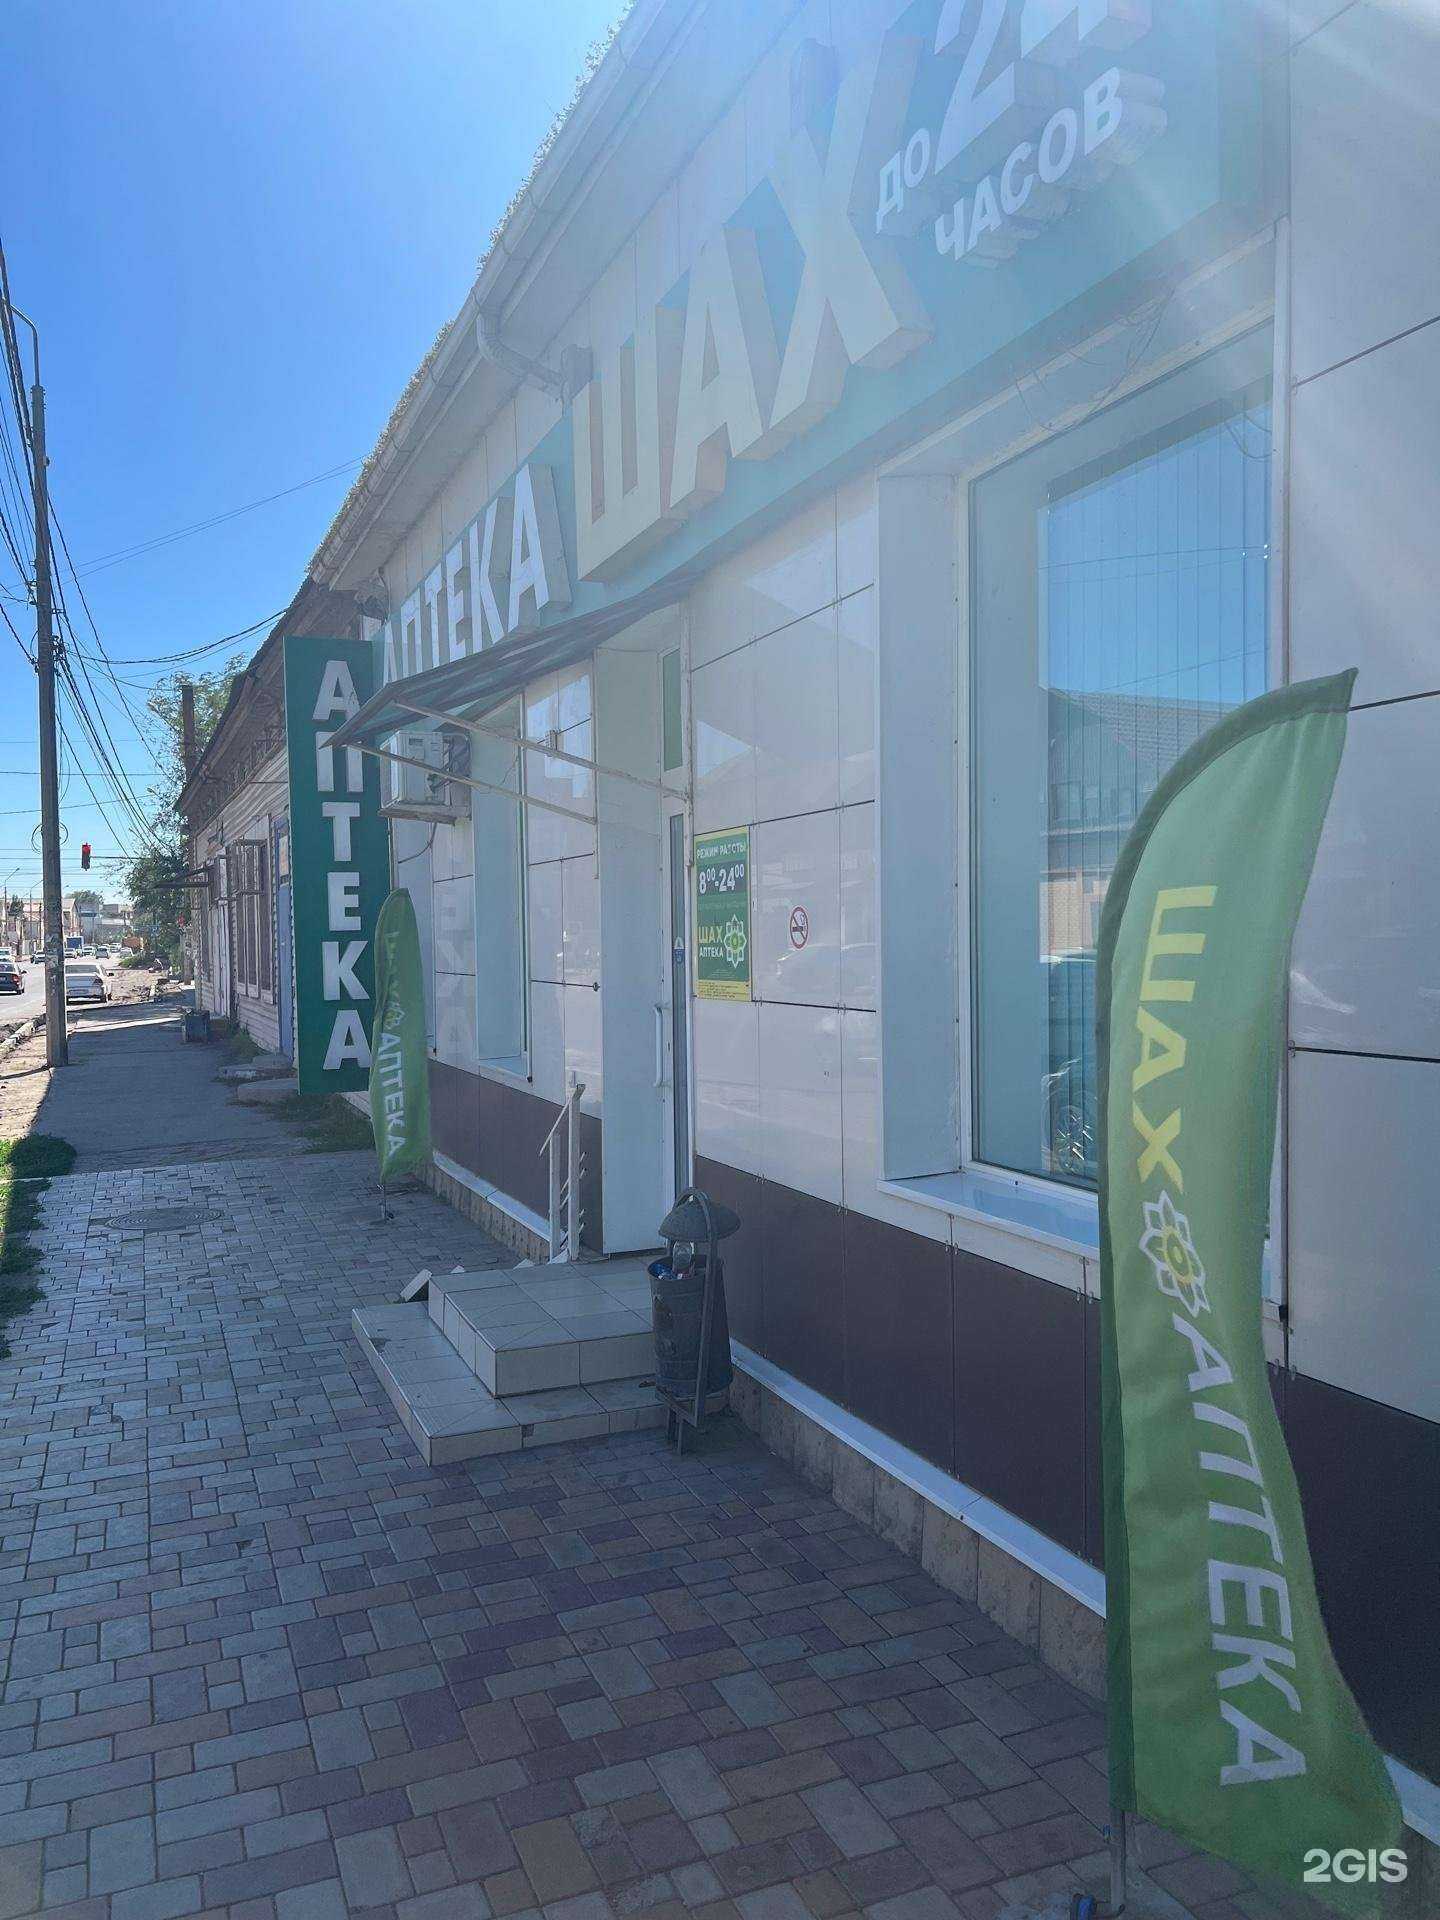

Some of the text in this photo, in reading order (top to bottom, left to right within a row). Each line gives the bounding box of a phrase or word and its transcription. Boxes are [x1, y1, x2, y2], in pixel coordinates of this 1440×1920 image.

[875, 128, 931, 234] ДО
[934, 66, 1123, 261] ЧАСОВ
[383, 30, 901, 686] АПТЕКА ШАХ
[311, 660, 372, 1070] АПТЕКА
[698, 925, 723, 944] ШАХ
[699, 946, 724, 958] АПТЕКА
[378, 1032, 406, 1157] АПТЕКА
[1132, 885, 1307, 1786] ШАХ АПТЕКА
